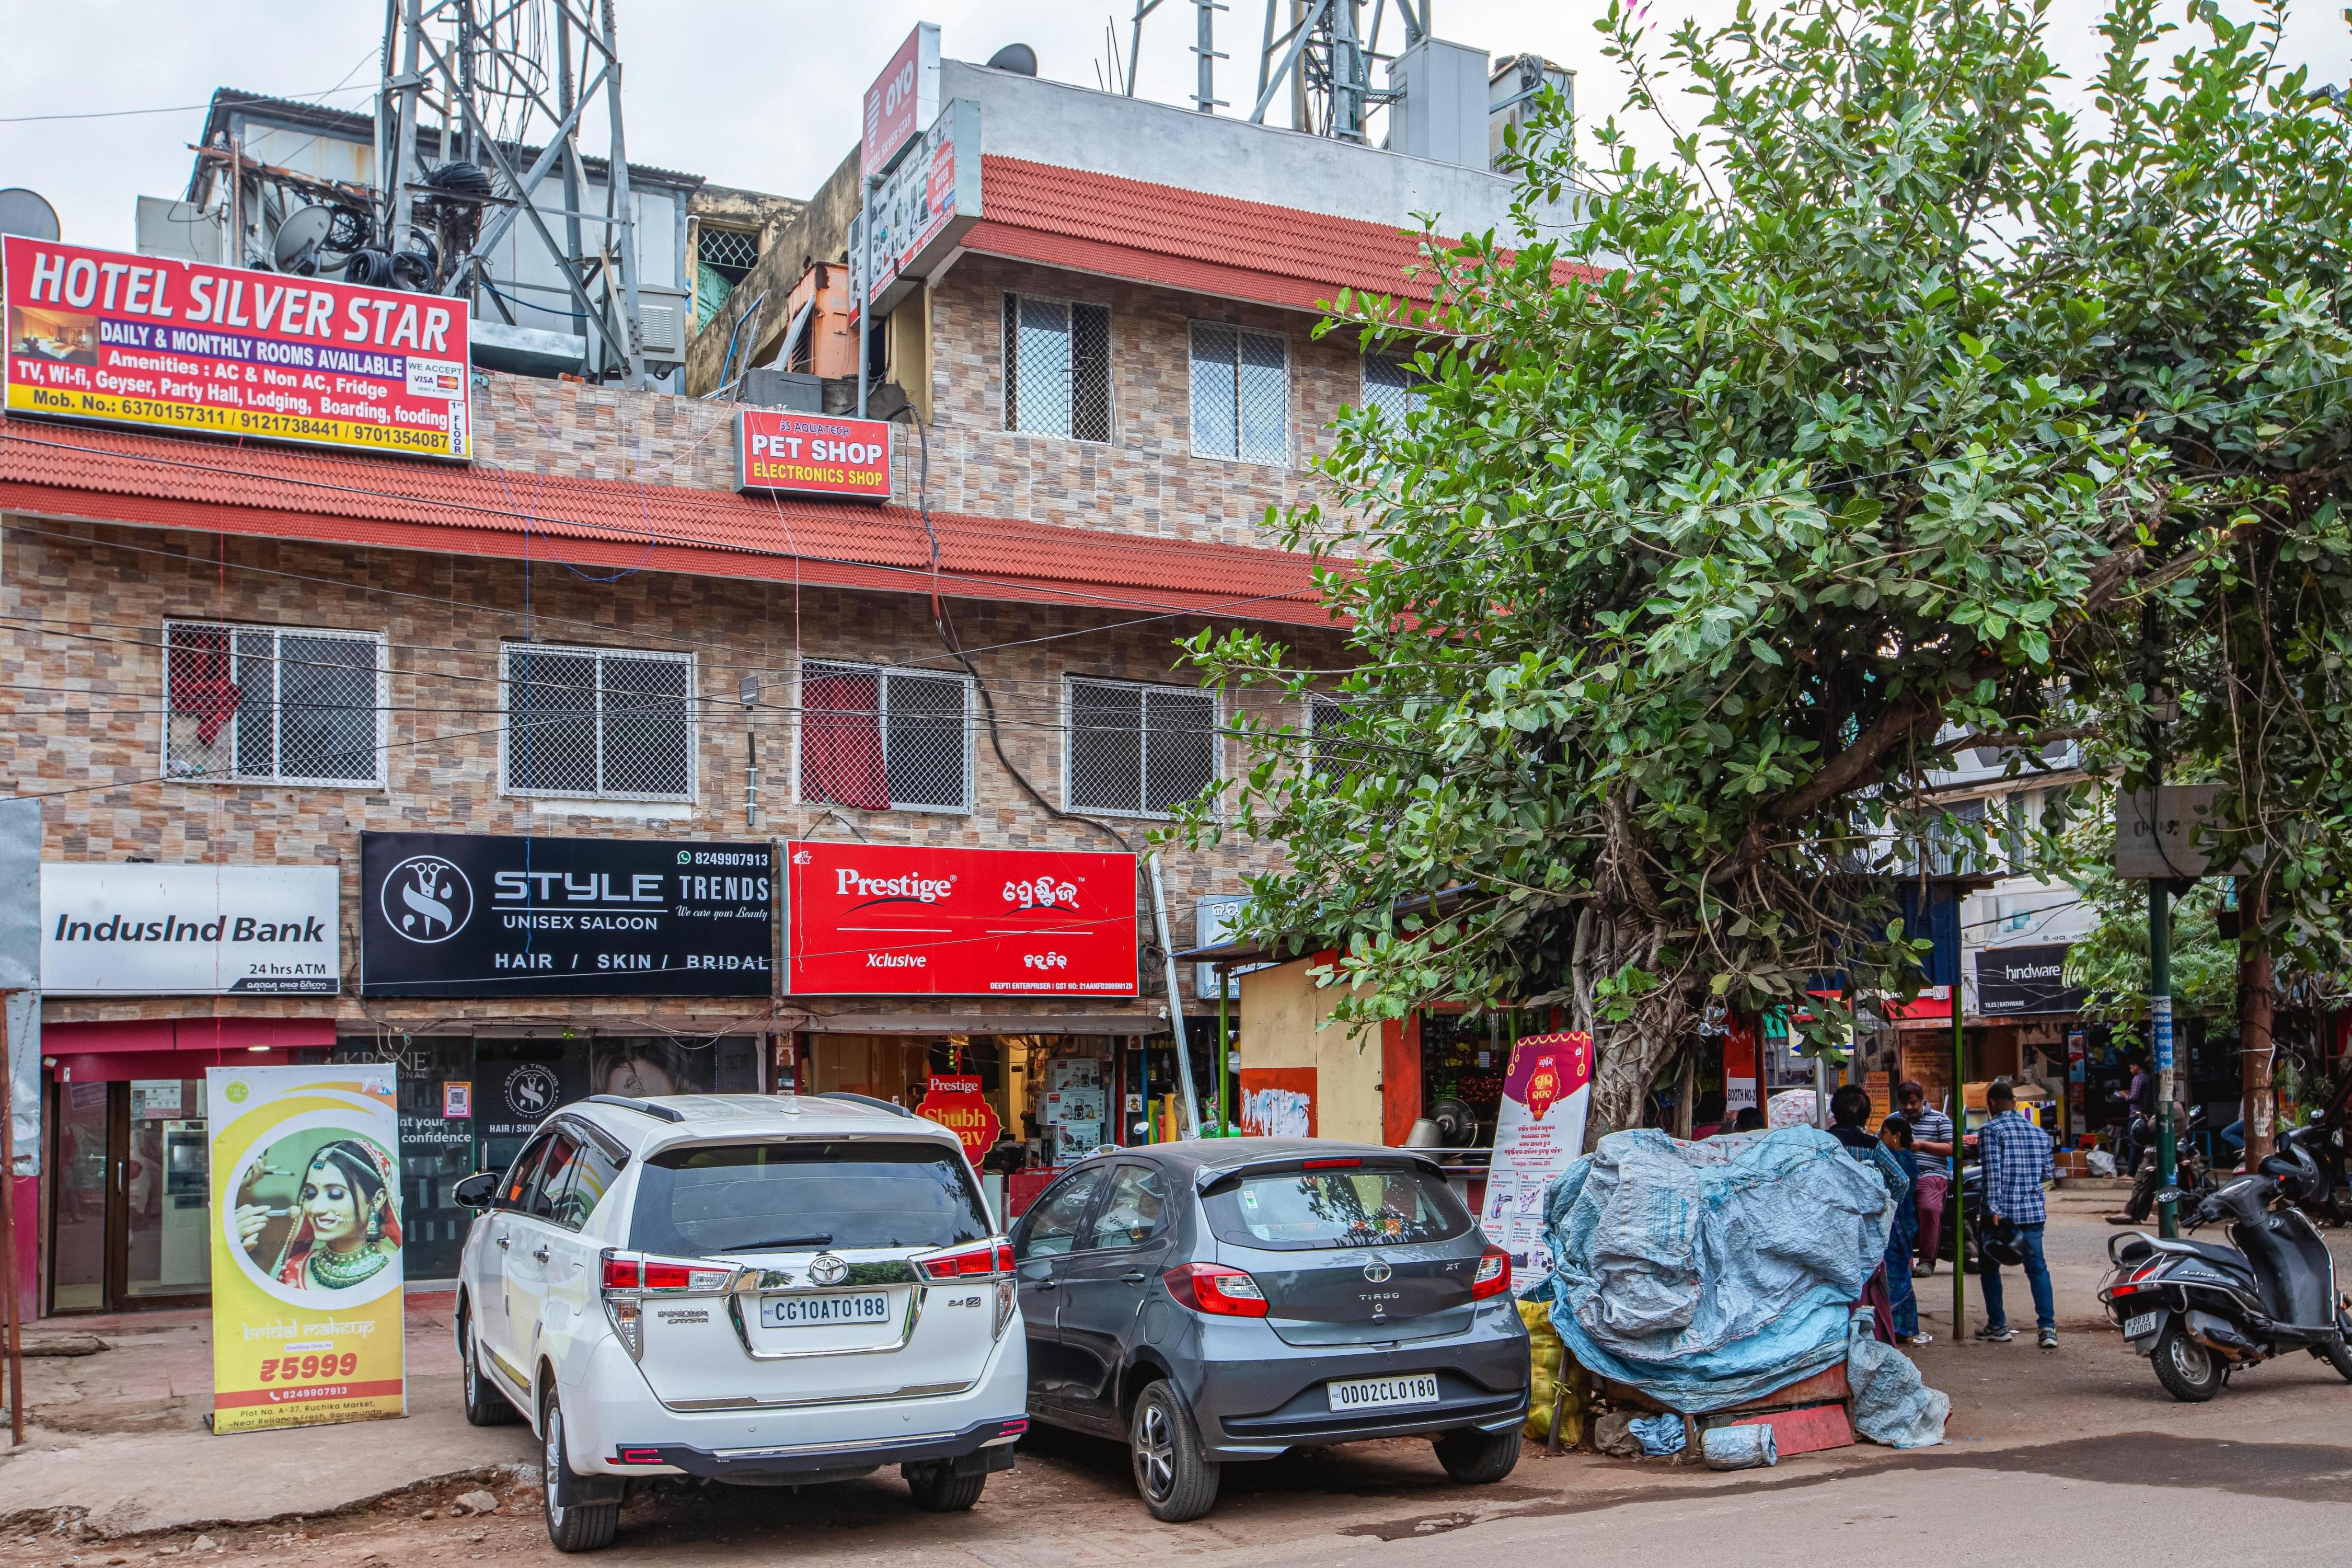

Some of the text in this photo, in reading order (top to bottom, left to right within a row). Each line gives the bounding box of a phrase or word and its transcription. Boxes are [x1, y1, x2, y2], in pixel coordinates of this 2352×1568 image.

[886, 60, 914, 117] OYO
[866, 113, 911, 174] HOTEL SILVER STAR
[930, 144, 953, 179] EXCHANGE
[935, 166, 949, 190] OFFER
[931, 178, 953, 211] AVAILABLE
[30, 252, 450, 352] HOTEL SILVER STAR
[101, 321, 402, 377] DAILY & MONTHLY ROOMS AVAILABLE
[109, 350, 388, 400] Amenities AC & Non AC, Fridge
[408, 362, 462, 375] WE ACCEPT
[414, 375, 433, 384] VISA
[18, 361, 448, 430] TV, Wi-fi, Geyser, Party Hall, Lodging, Boarding, fooding
[34, 389, 75, 408] Mob.
[82, 395, 116, 412] No.:
[122, 399, 225, 424] 6370157311
[241, 413, 339, 436] 9121738441
[354, 425, 448, 448] 9701354087
[780, 421, 850, 438] SS AQUATECH
[752, 434, 882, 465] PET SHOP
[753, 463, 882, 486] ELECTRONICS SHOP
[696, 852, 768, 866] 8249907913
[494, 871, 768, 902] STYLE TRENDS
[836, 869, 952, 903] Prestige
[676, 905, 690, 916] We
[714, 911, 733, 920] your
[735, 906, 767, 921] Beauty
[55, 914, 326, 942] IndusInd Bank
[504, 916, 658, 930] UNISEX SALOON
[250, 963, 326, 974] 24 hrs ATM
[495, 954, 768, 970] HAIR / SKIN / BRIDAL
[866, 953, 926, 968] Xclusive
[2006, 963, 2061, 979] hindware
[505, 1064, 559, 1087] STYLE TRENDS
[930, 1078, 978, 1093] Prestige
[1728, 1089, 1744, 1101] BOOTH
[416, 1117, 445, 1128] your
[925, 1109, 985, 1127] Shubh
[402, 1132, 471, 1143] confidence
[490, 1124, 510, 1133] HAIR
[658, 1308, 709, 1317] INNOVA
[776, 1298, 884, 1320] CG10AT0188
[2132, 1321, 2152, 1334] P4005
[2134, 1314, 2149, 1325] OD33
[243, 1317, 375, 1341] bridal makeup
[260, 1353, 357, 1381] ₹5999
[283, 1387, 347, 1399] 8249907913
[1341, 1379, 1435, 1404] OD02CL0180
[279, 1405, 302, 1414] A-37,
[305, 1403, 340, 1412] Ruchika
[343, 1400, 375, 1409] Market,
[233, 1408, 382, 1427] Near Reliance Fresh, Baramunda
